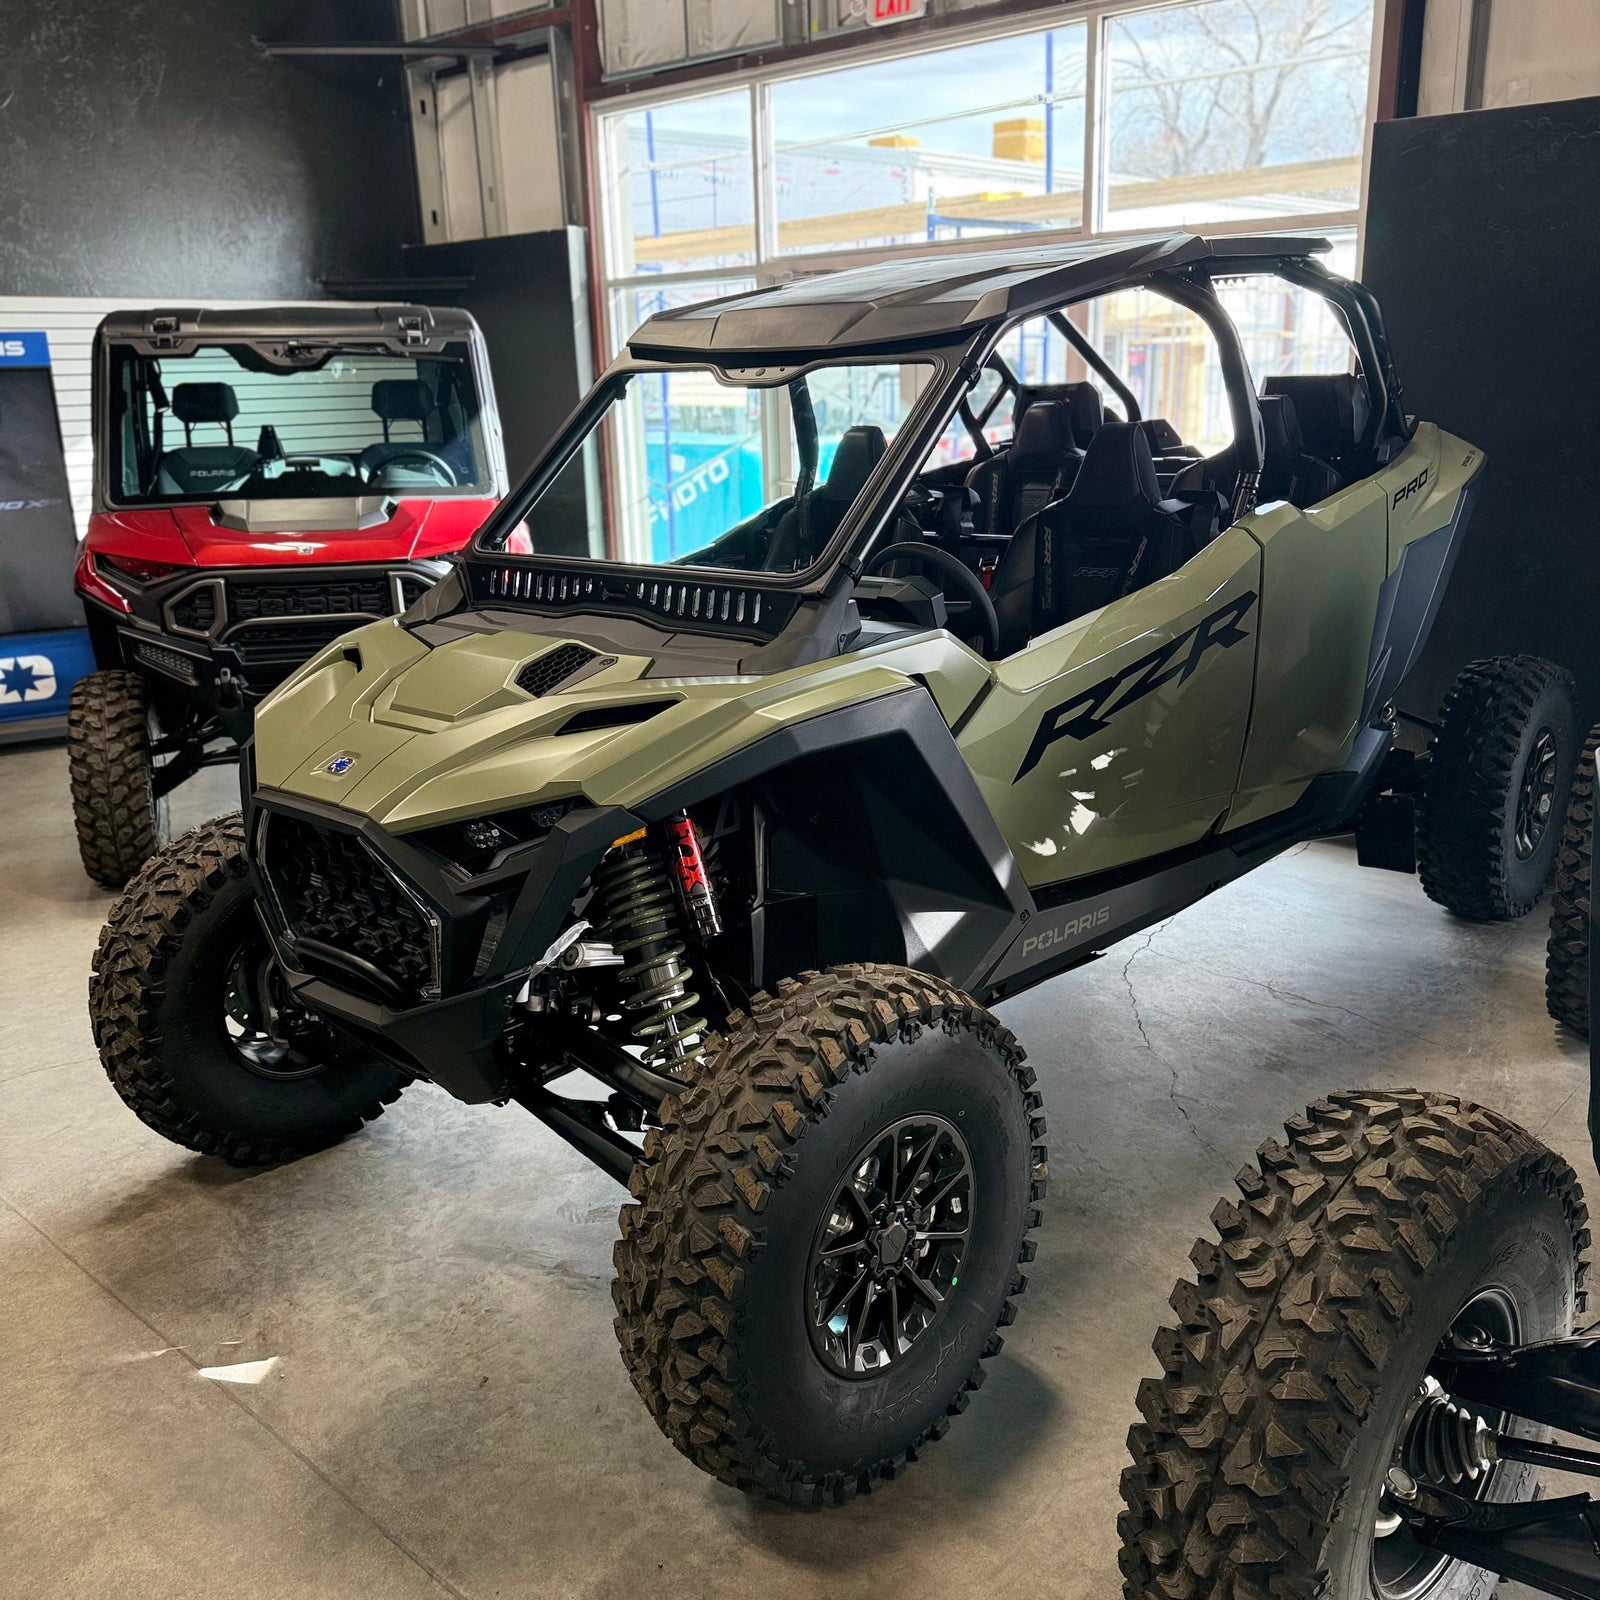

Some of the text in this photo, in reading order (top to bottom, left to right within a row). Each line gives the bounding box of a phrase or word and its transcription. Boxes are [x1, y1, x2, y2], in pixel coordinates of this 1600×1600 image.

[190, 469, 236, 477] POLARIS
[1392, 467, 1429, 511] PRO
[236, 593, 385, 617] POLARIS
[1011, 590, 1258, 786] RZR
[668, 819, 712, 893] FOX
[1023, 905, 1110, 958] POLARIS
